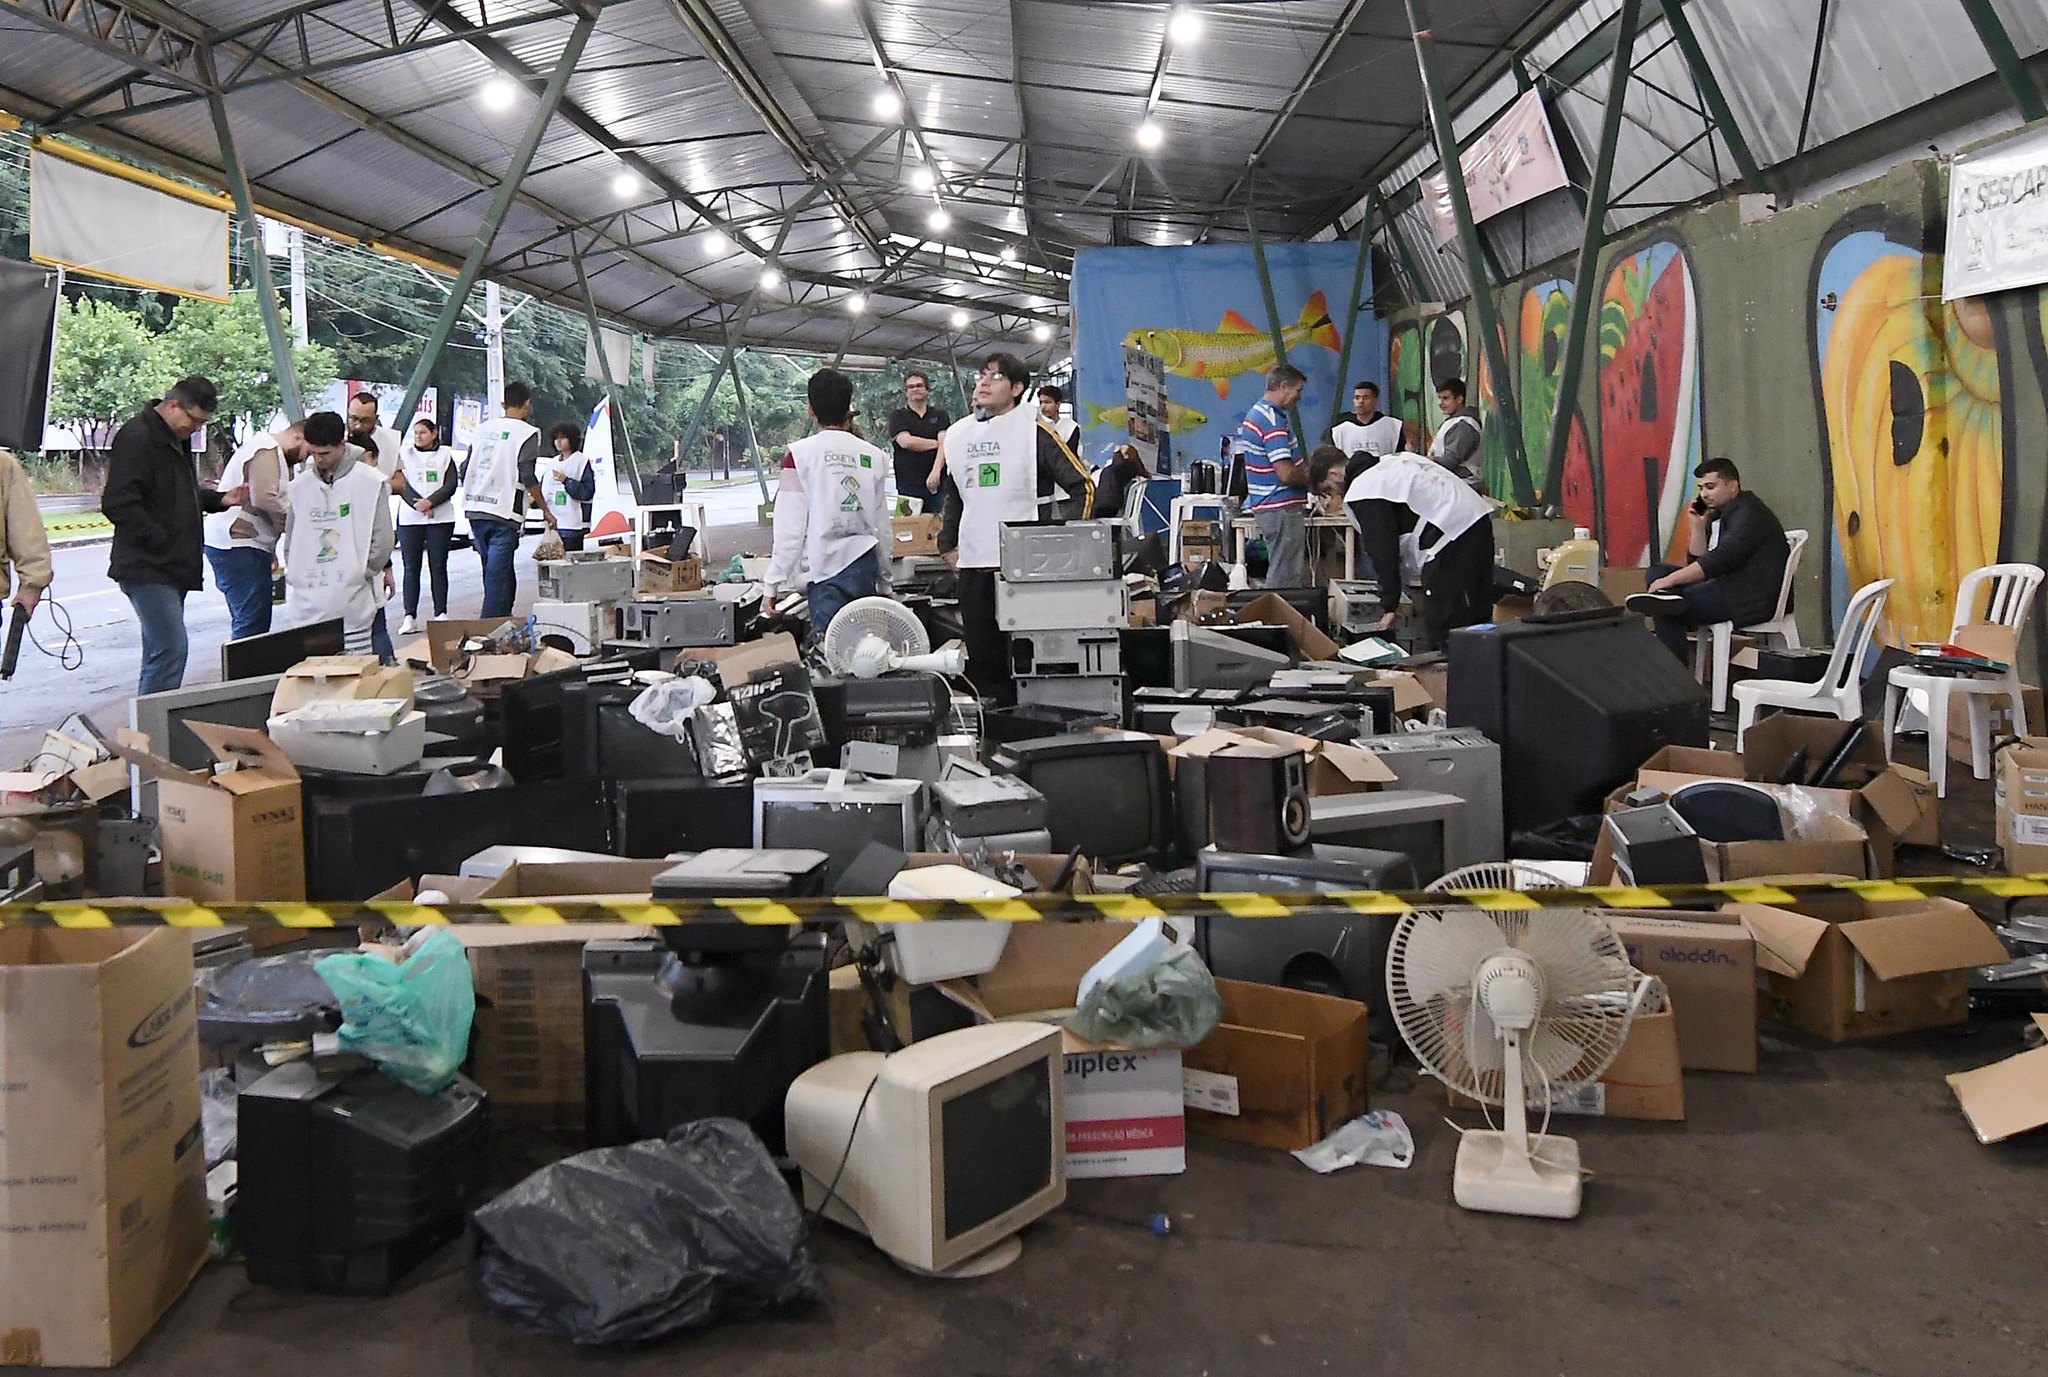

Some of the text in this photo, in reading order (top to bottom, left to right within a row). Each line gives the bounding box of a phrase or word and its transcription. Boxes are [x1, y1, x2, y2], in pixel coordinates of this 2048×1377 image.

[966, 441, 1001, 453] OLETA
[730, 677, 783, 701] TAIFF
[1659, 946, 1730, 964] aladdin
